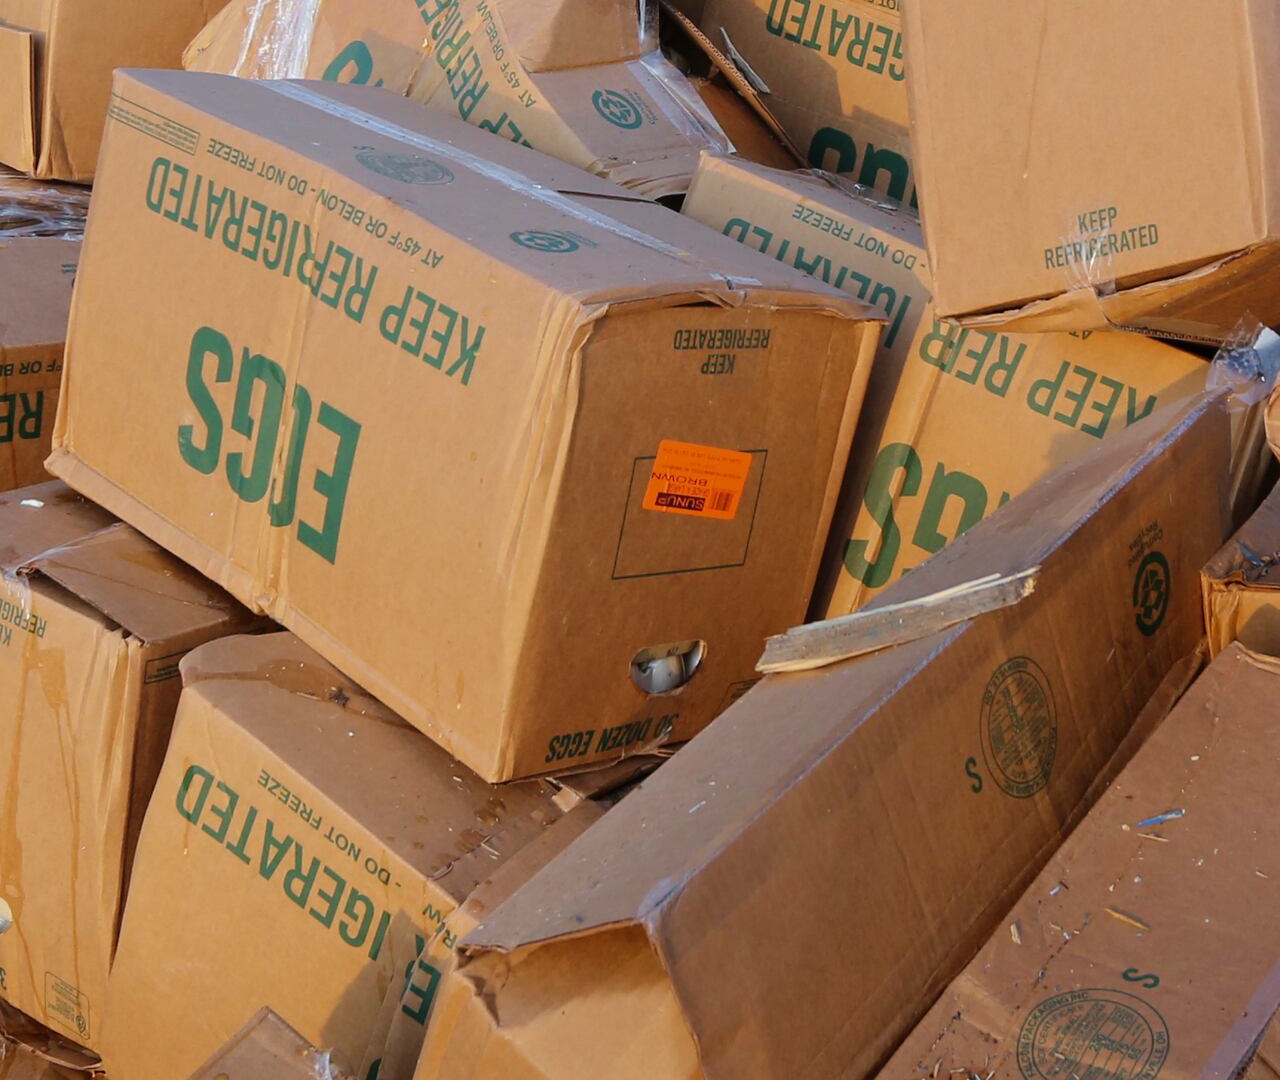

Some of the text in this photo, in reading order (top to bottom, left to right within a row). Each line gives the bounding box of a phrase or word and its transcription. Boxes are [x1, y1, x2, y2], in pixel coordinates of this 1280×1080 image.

[518, 88, 537, 108] AT
[207, 137, 445, 270] AT 45°F OR BELOW DO NOT FREEZE
[1078, 207, 1117, 234] KEEP
[792, 204, 919, 271] DO NOT FREEZE
[1044, 224, 1159, 270] REFRIGERATED
[145, 156, 487, 386] KEEP REFRIGERATED
[673, 328, 771, 350] REFRIGERATED
[18, 361, 43, 376] OR
[700, 354, 736, 375] KEEP
[651, 471, 709, 487] BROWN
[657, 492, 705, 511] SUNUP
[544, 730, 596, 763] EGGS
[595, 718, 649, 752] DOZEN
[257, 767, 392, 887] DO NOT FREEZE
[1122, 967, 1161, 989] S
